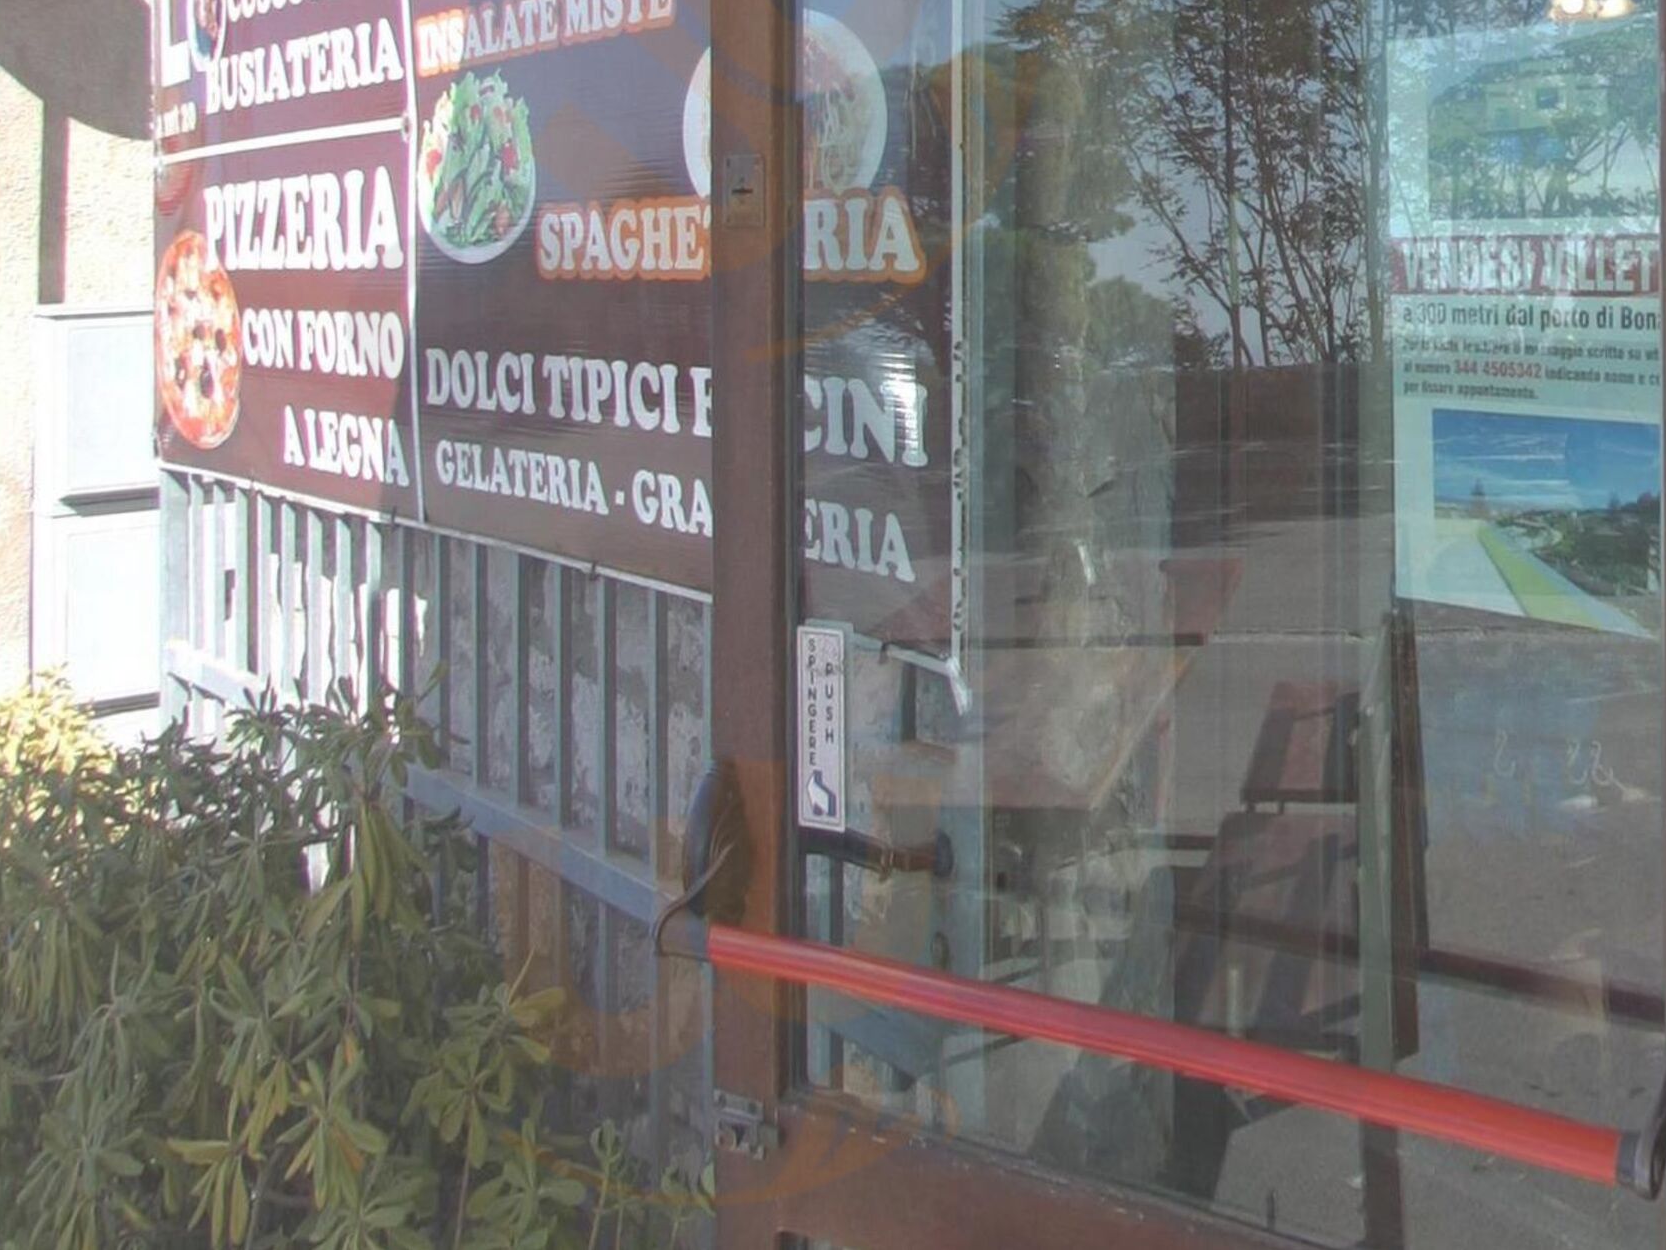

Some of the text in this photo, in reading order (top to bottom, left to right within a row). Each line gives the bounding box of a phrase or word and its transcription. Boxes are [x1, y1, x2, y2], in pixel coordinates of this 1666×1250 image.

[205, 17, 405, 115] BUSIATERIA
[202, 165, 404, 272] PIZZERIA
[1401, 238, 1661, 291] VENDESI VILLET
[241, 307, 405, 379] CON FORNO
[1452, 303, 1499, 326] metri
[1505, 303, 1533, 327] dal
[1596, 305, 1614, 329] di
[1620, 305, 1661, 330] Bon
[425, 348, 536, 415] DOLCI
[542, 355, 681, 434] TIPICI
[284, 404, 410, 487] A LEGNA
[435, 439, 609, 516] GELATERIA
[806, 637, 818, 766] SPINGERE
[824, 662, 834, 745] PUSH
